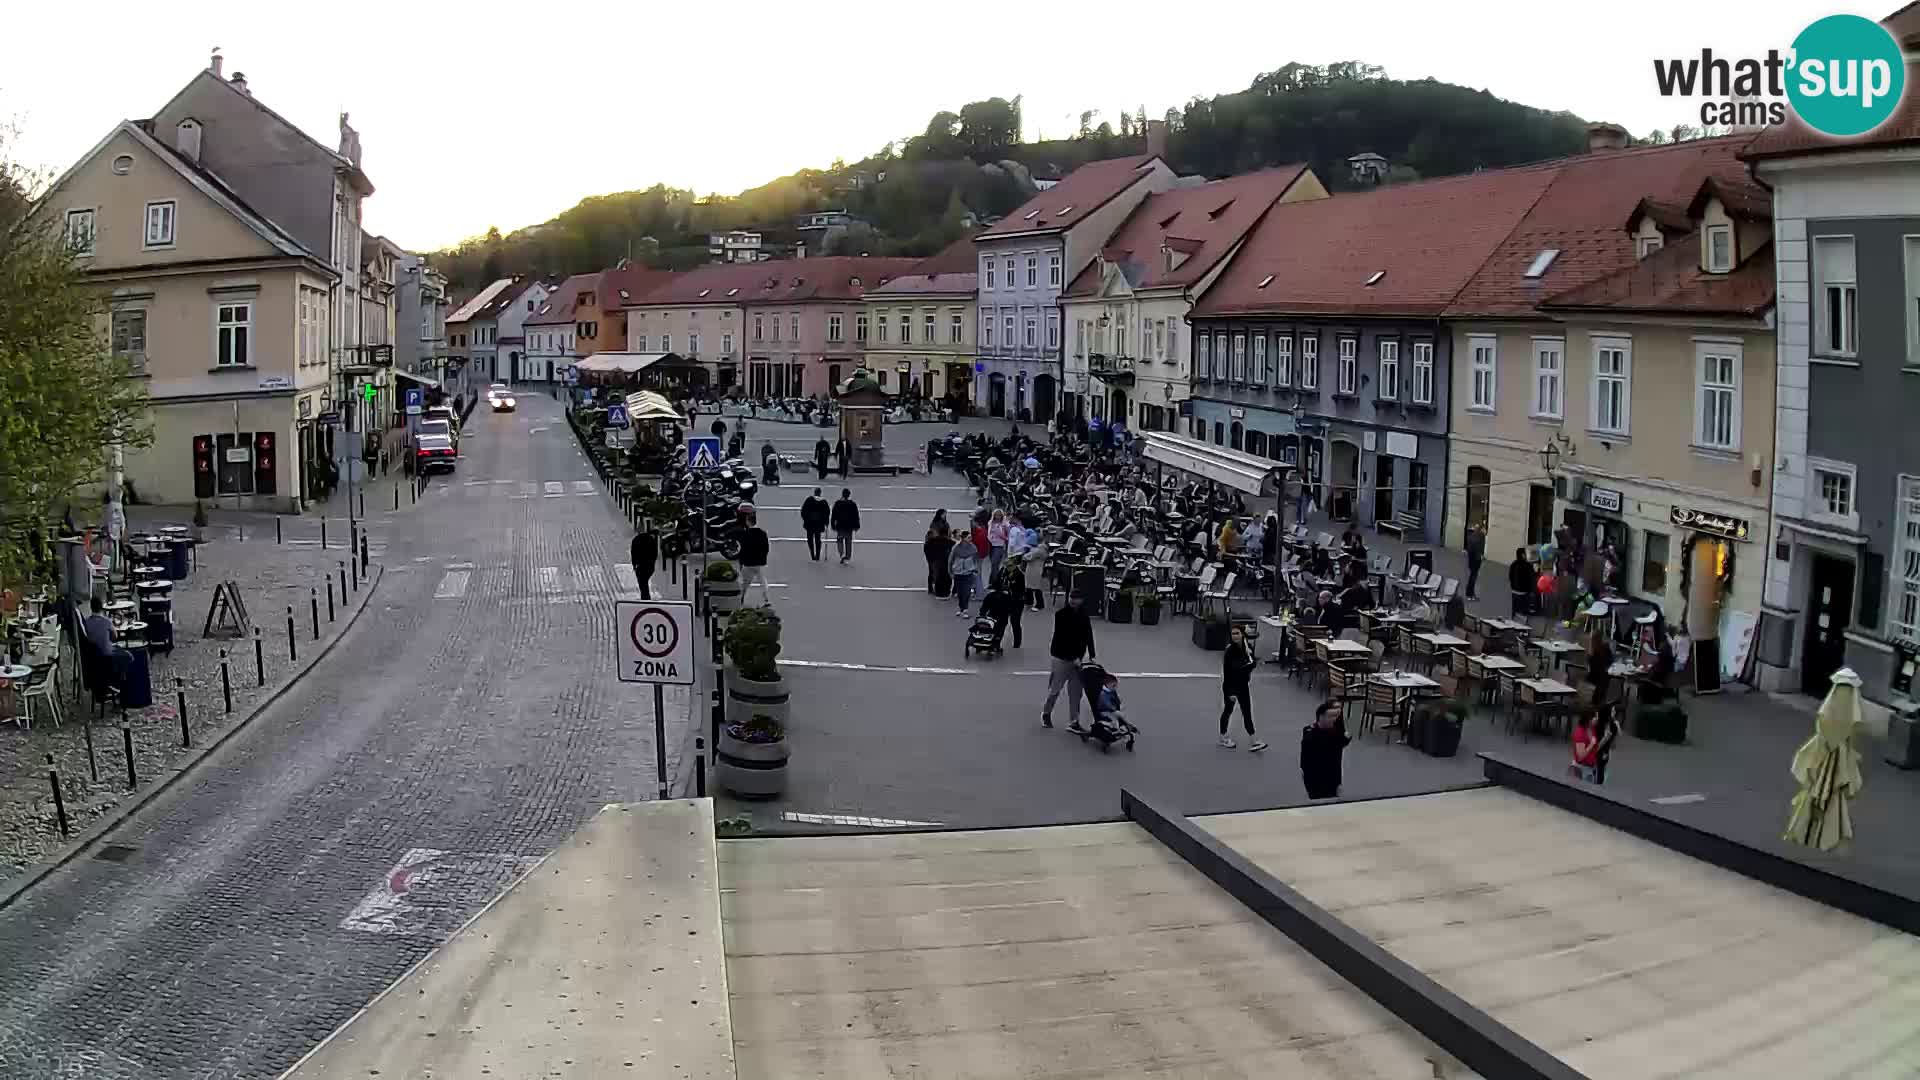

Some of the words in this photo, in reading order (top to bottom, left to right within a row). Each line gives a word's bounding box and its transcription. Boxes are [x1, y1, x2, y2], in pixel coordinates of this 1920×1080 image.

[411, 392, 418, 404] P
[643, 623, 667, 645] 30
[633, 660, 678, 677] ZONA
